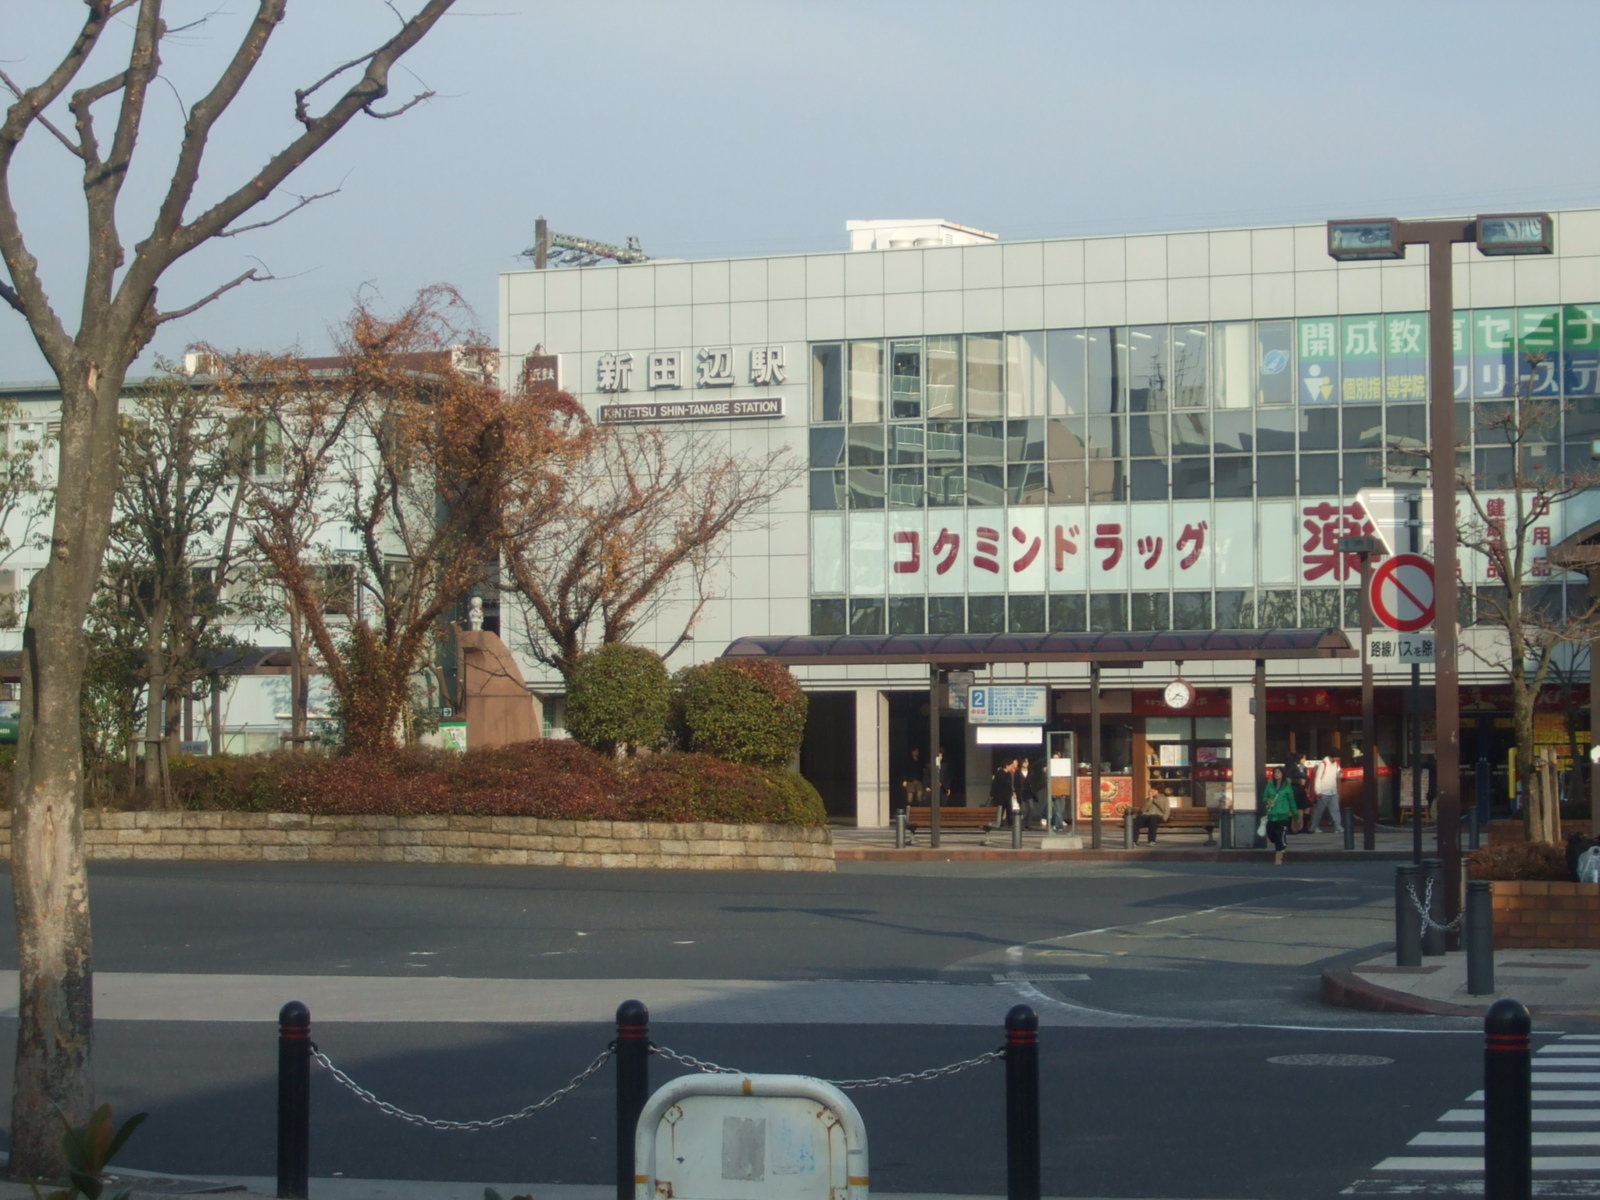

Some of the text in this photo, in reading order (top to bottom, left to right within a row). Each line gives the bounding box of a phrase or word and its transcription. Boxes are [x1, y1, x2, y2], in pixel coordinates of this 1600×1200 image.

[598, 345, 786, 391] 新田辺駅
[1343, 375, 1426, 401] 個別指導学院
[604, 400, 778, 421] KINTETSU SHIN-TANABE STATION
[893, 520, 1208, 576] コクミンドラッグ
[1303, 502, 1381, 581] 薬
[1532, 495, 1552, 577] 日用品
[1371, 640, 1437, 657] 路線バスを除
[974, 692, 983, 705] 2
